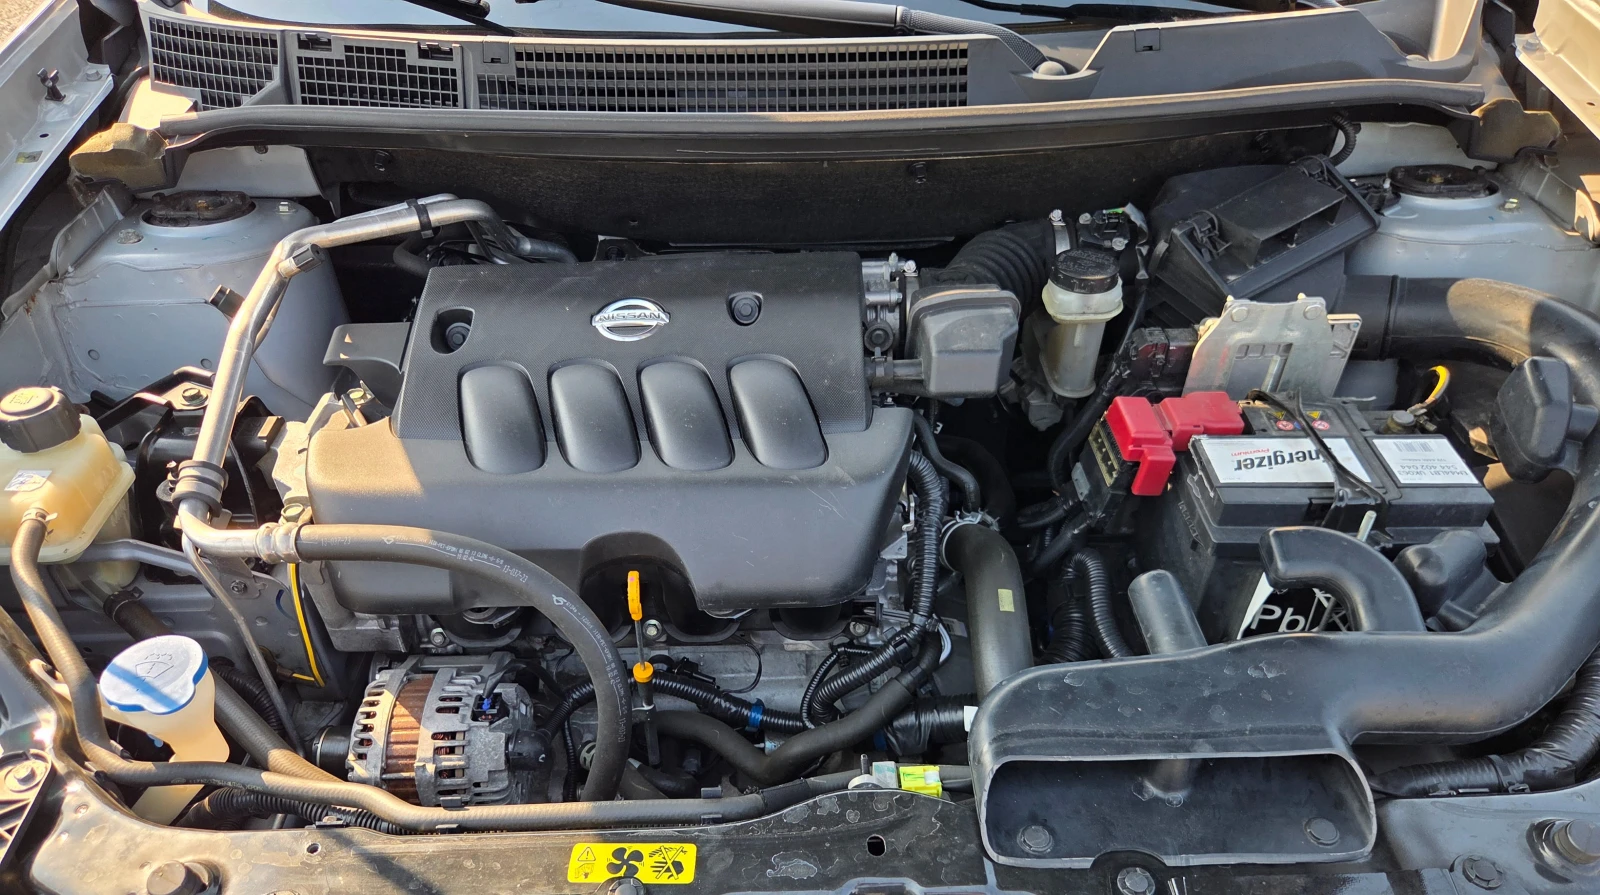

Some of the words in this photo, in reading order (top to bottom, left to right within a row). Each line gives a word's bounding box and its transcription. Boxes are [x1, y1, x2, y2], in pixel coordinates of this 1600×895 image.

[600, 311, 661, 321] NISSAN
[1231, 448, 1270, 458] Premium
[1234, 448, 1330, 471] nergizer
[502, 564, 529, 583] 13-037-23
[1250, 604, 1306, 632] Pb
